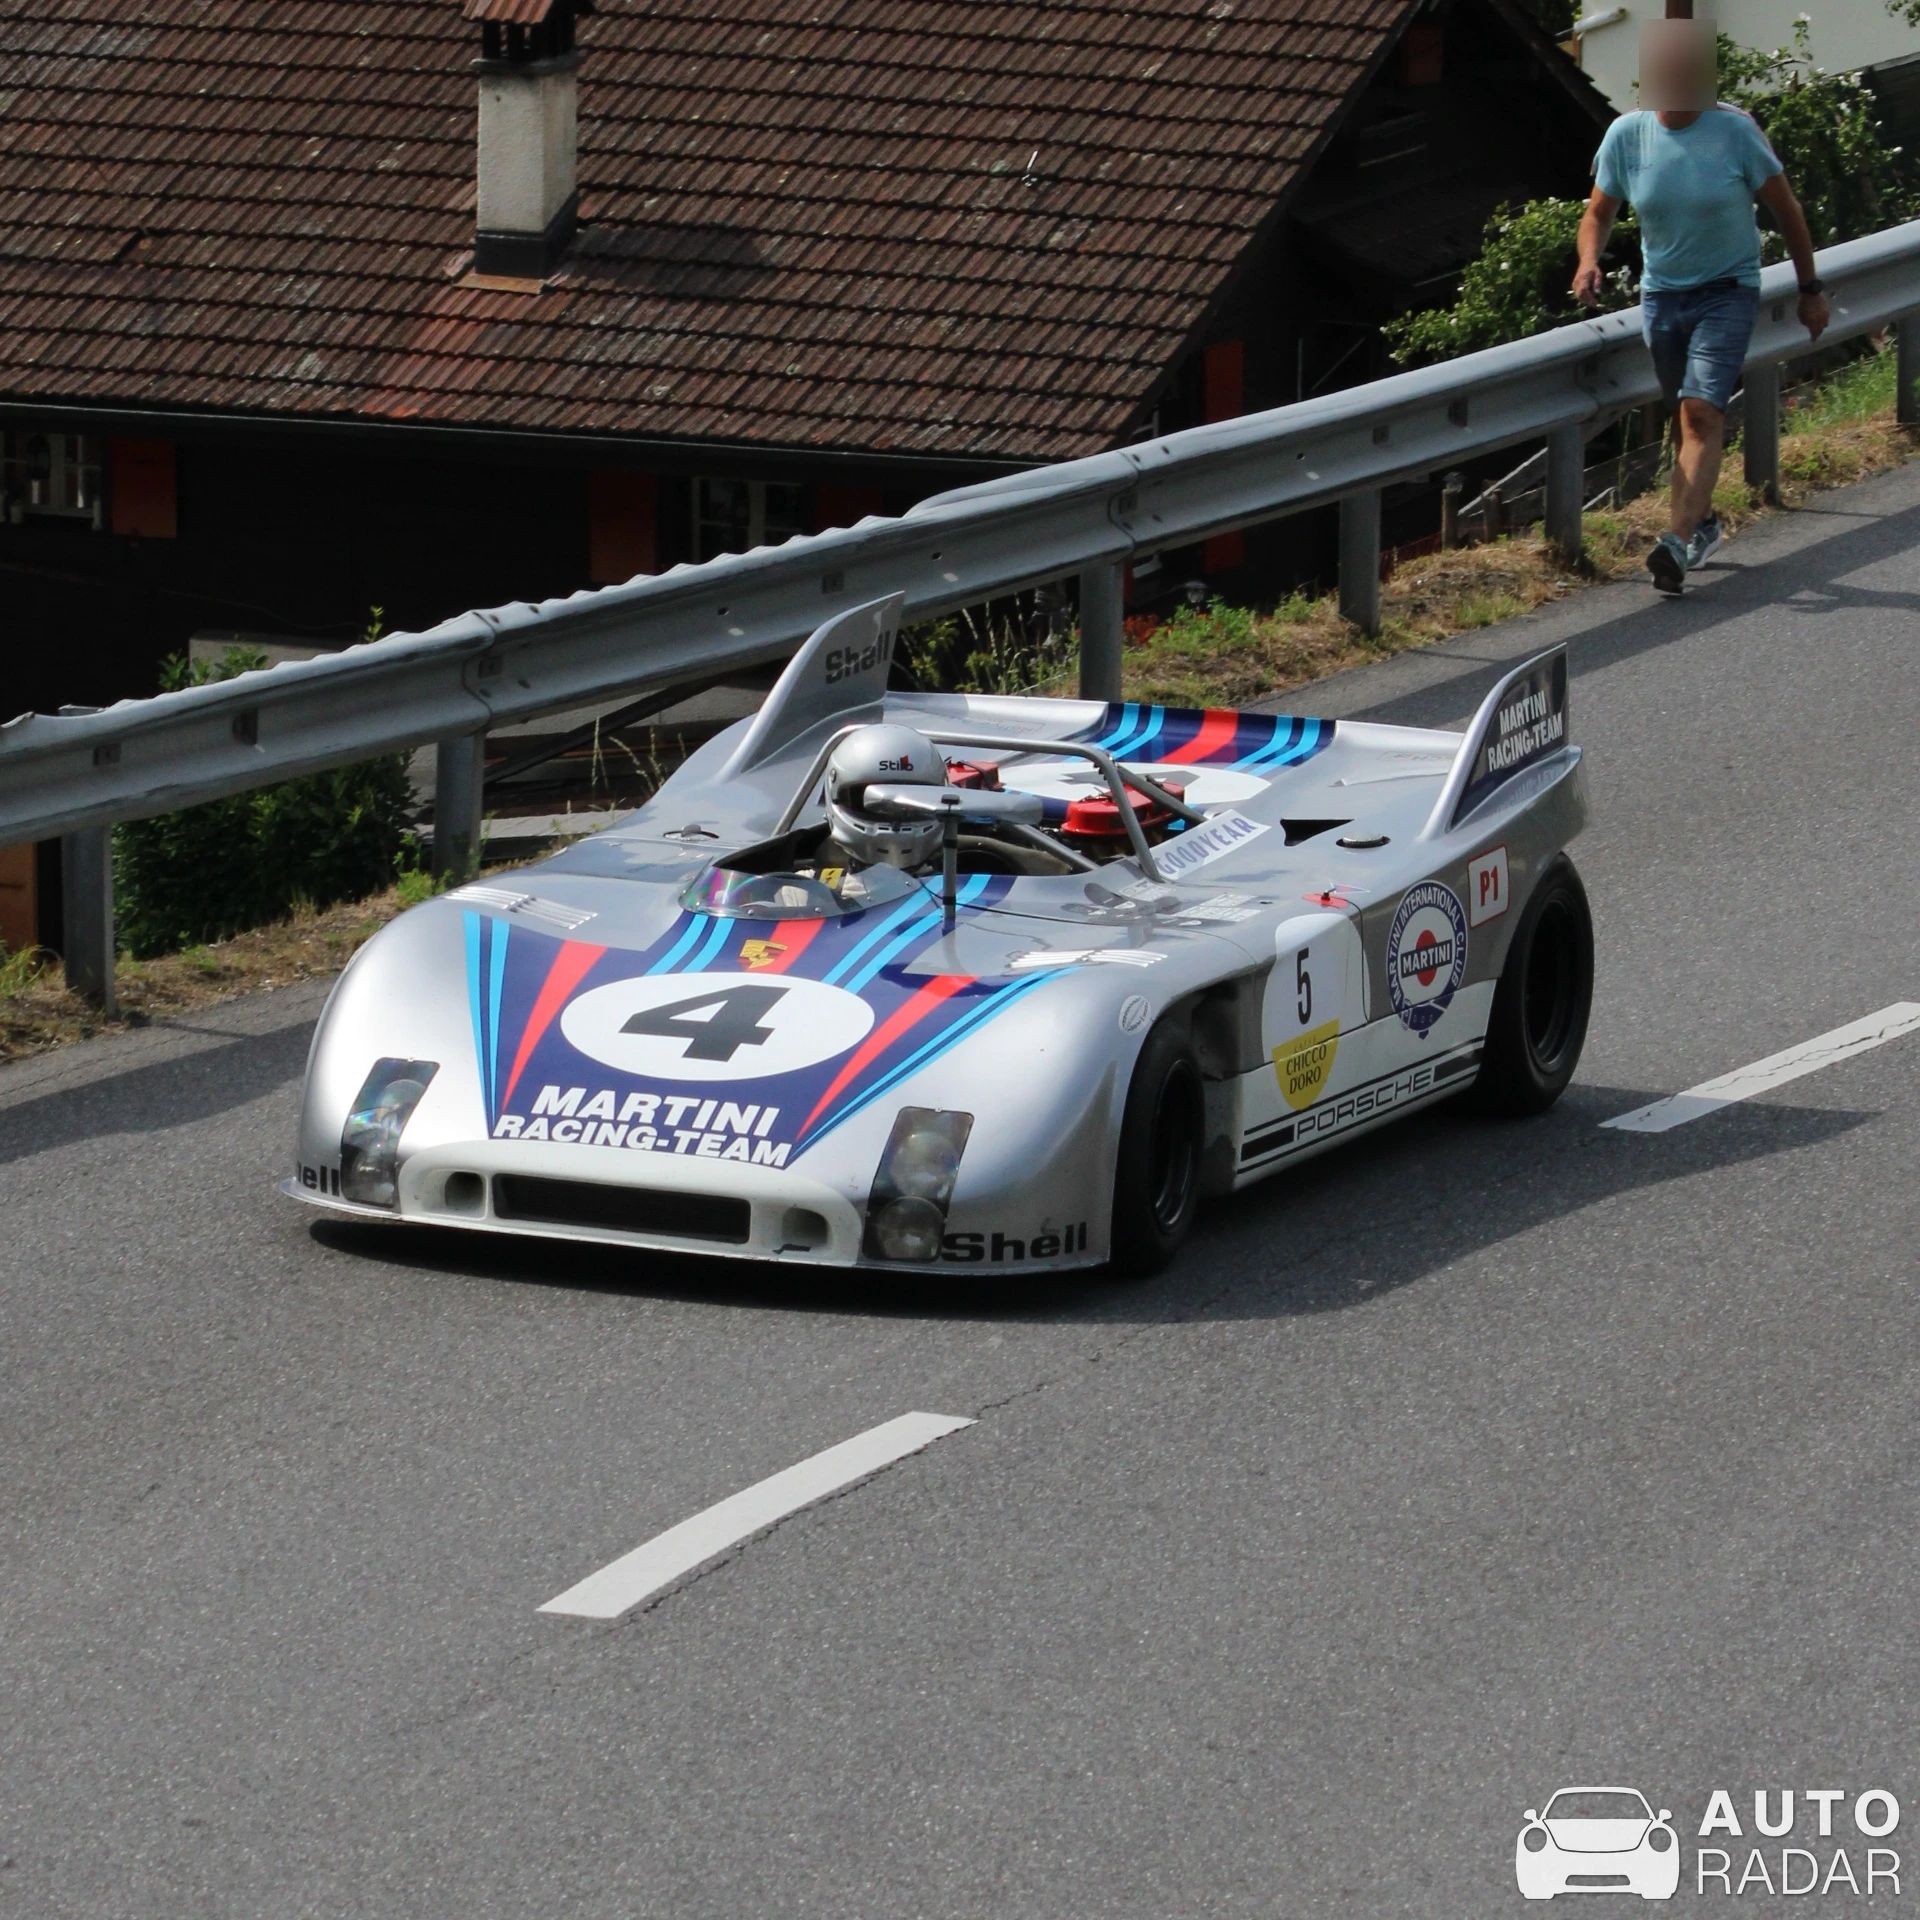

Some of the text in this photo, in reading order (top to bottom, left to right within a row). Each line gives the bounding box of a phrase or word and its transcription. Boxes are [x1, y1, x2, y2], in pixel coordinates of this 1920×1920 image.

[825, 630, 891, 685] Shell
[1499, 690, 1547, 735] MARTINI
[879, 755, 914, 771] Stilo
[1487, 711, 1564, 772] RACING-TEAM
[1157, 816, 1257, 874] GOODYEAR
[1479, 865, 1499, 907] P1
[1389, 886, 1465, 1005] MARTINI INTERNATIONAL CLUB
[1402, 943, 1451, 974] MARTINI
[1296, 947, 1312, 1025] 5
[618, 984, 792, 1063] 4
[1286, 1044, 1327, 1075] CHICCO
[530, 1085, 780, 1138] MARTINI
[1296, 1066, 1434, 1140] PORSCHE
[493, 1114, 792, 1167] RACING-TEAM
[297, 1161, 340, 1197] ell
[940, 1221, 1087, 1262] Shell
